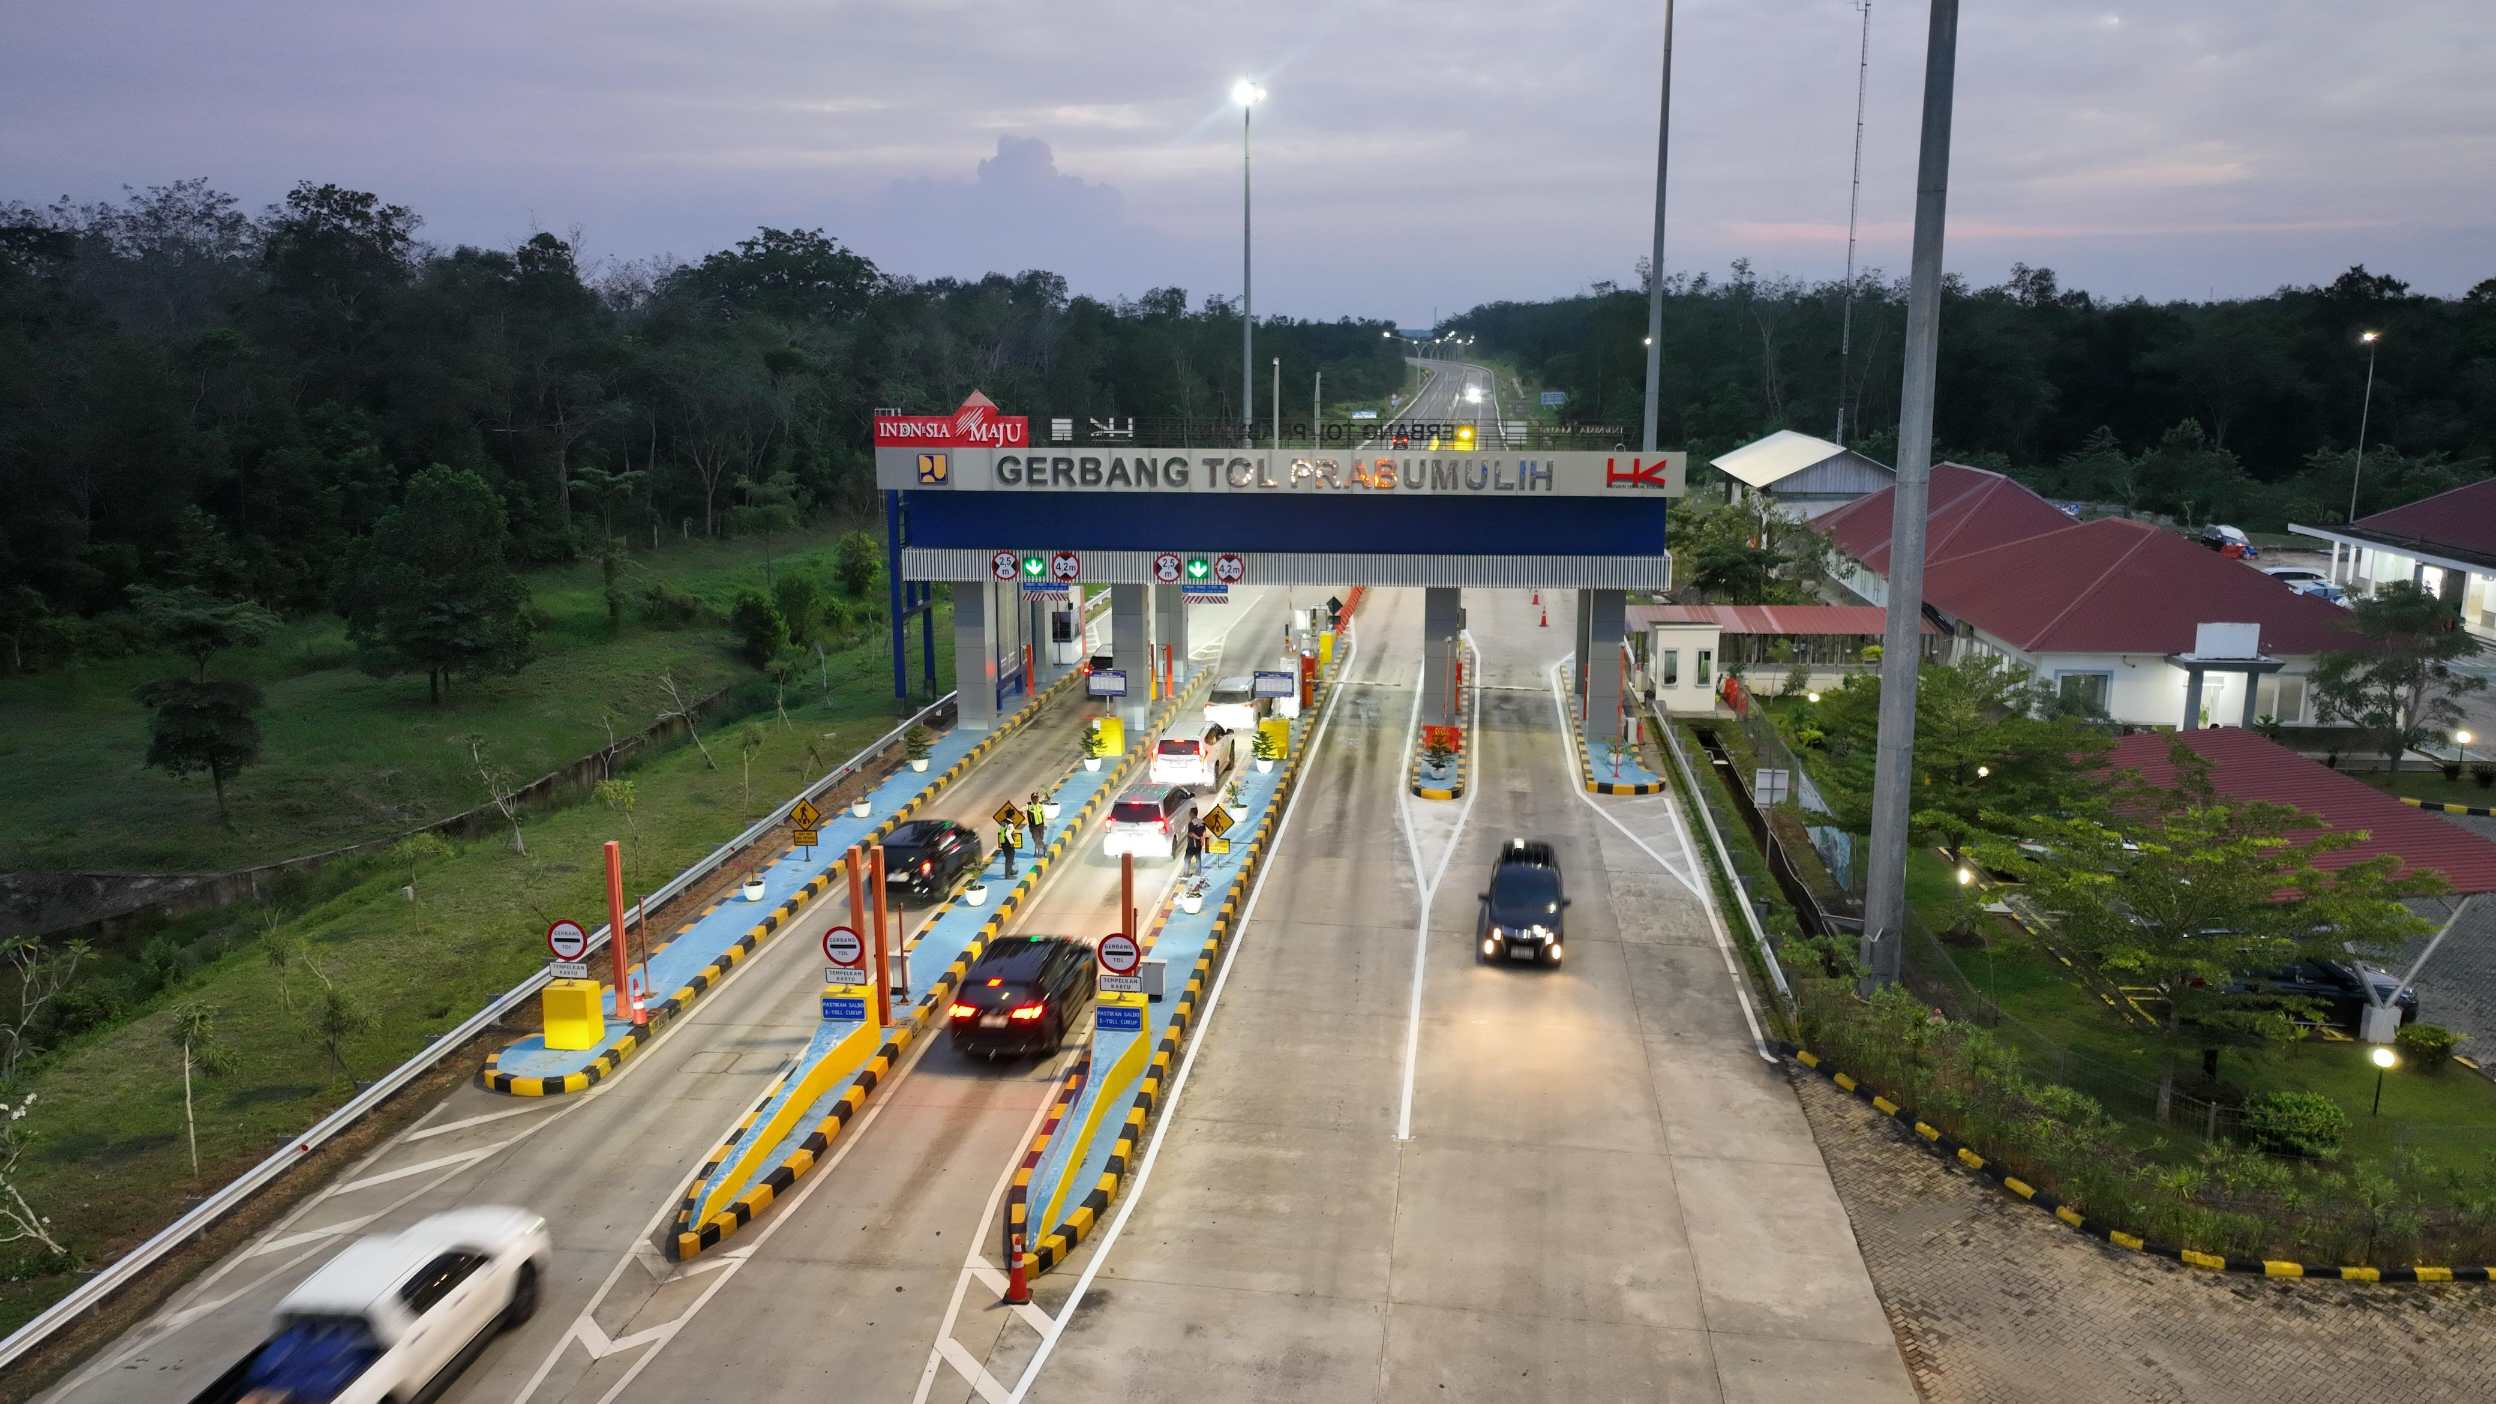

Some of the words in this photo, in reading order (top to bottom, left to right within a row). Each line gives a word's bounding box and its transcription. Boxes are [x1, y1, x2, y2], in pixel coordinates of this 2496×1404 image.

[880, 422, 950, 438] INDONESIA
[968, 422, 1022, 448] MAJU
[997, 455, 1189, 487] GERBANG
[1202, 457, 1279, 489] TOL
[1291, 458, 1554, 491] PRABUMULIH
[1606, 457, 1667, 488] HK
